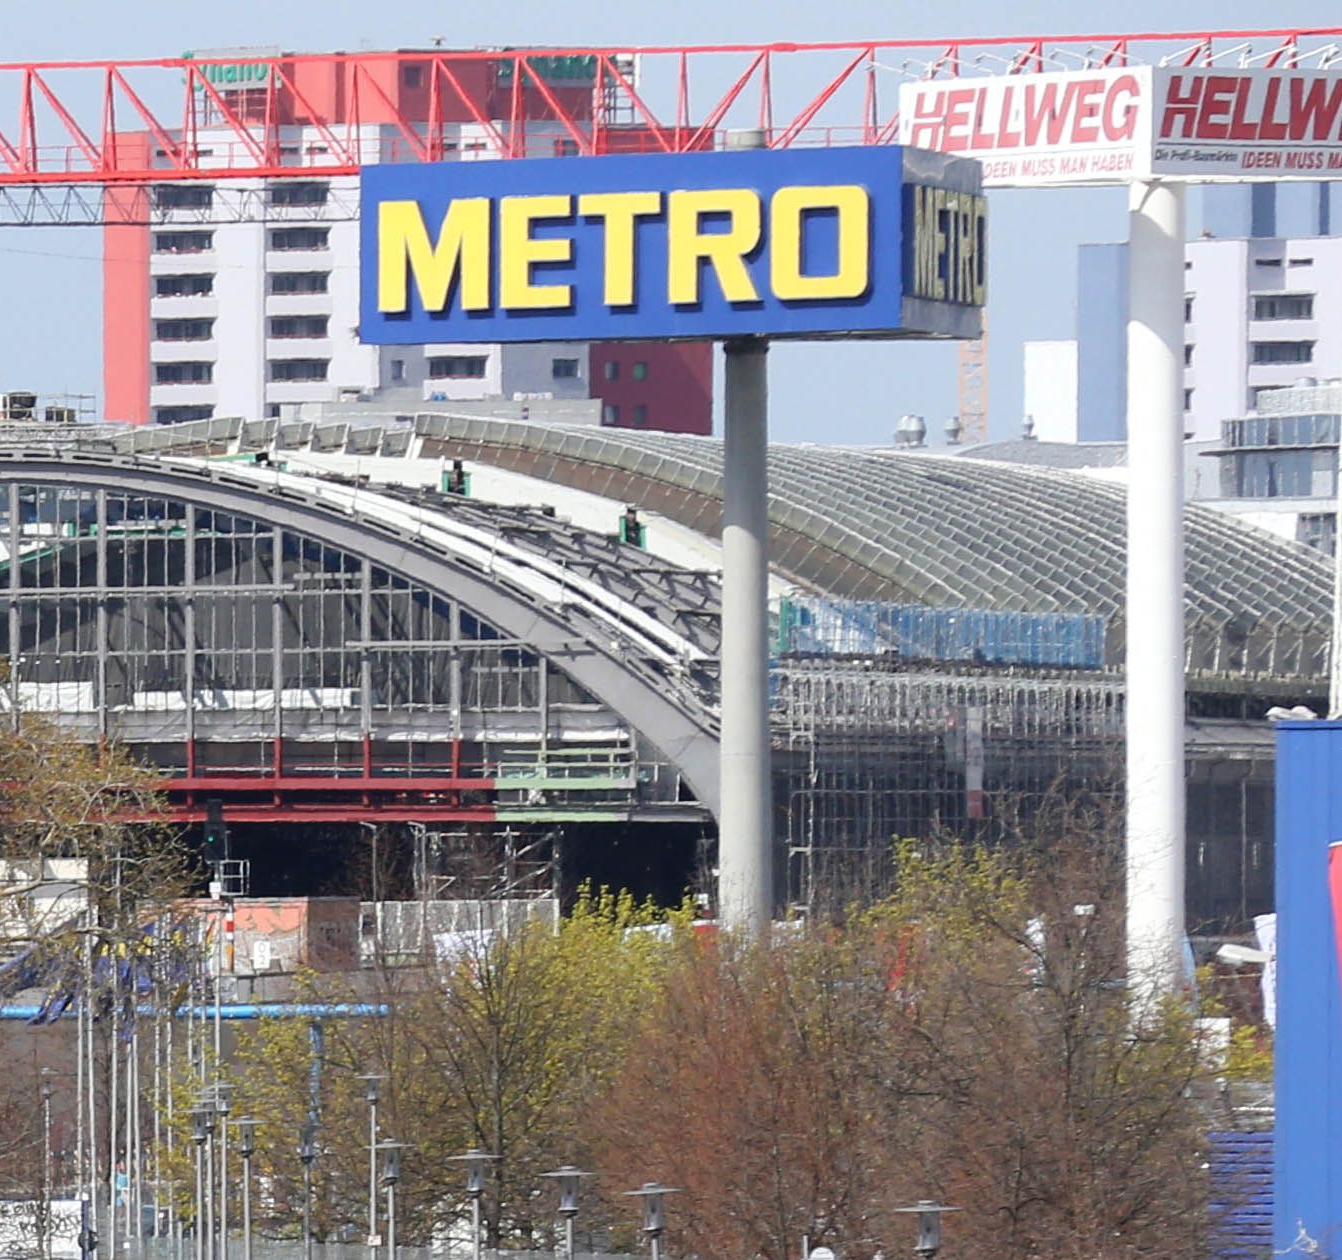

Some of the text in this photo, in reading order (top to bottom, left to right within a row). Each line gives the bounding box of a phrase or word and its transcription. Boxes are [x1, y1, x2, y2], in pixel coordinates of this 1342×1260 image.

[911, 75, 1140, 152] HELLWEG
[1159, 75, 1342, 141] HELLW
[982, 152, 1134, 179] DEEN MUSS MAN HABEN
[1241, 151, 1342, 169] IDEEN MUSS MA
[378, 185, 869, 313] METRO
[914, 185, 989, 305] METRO
